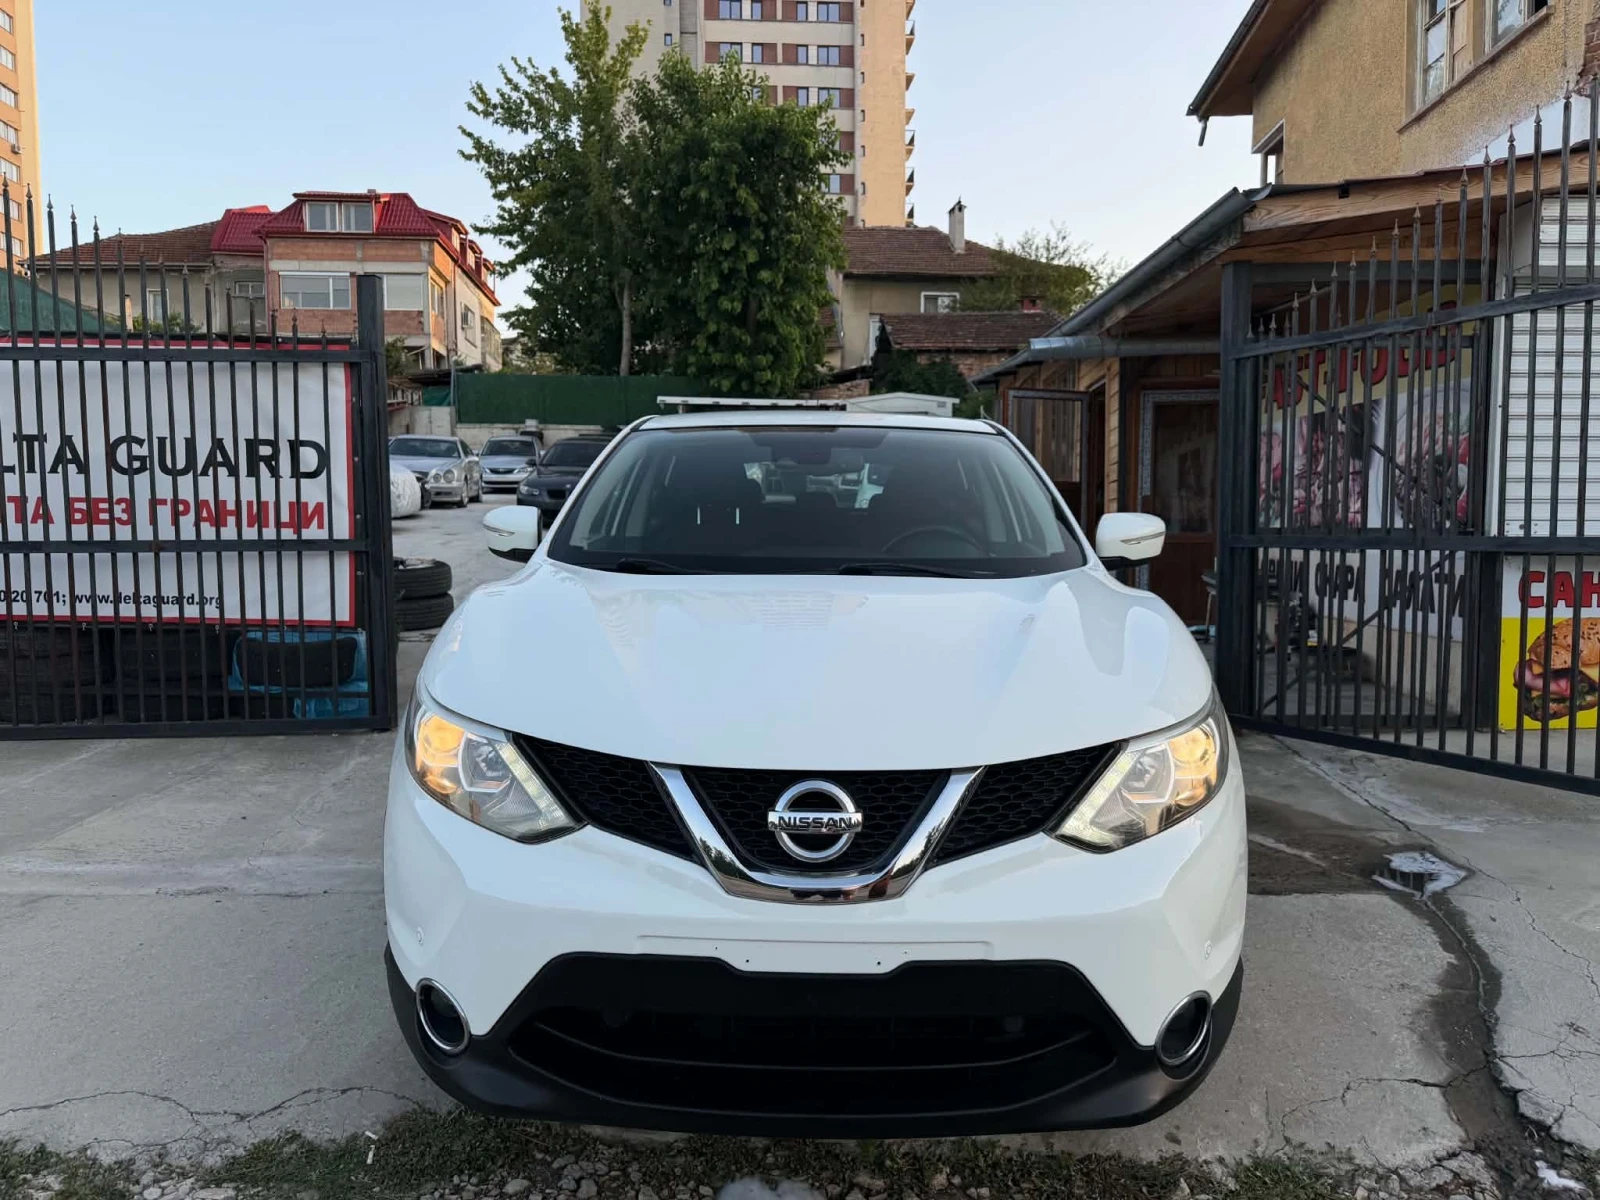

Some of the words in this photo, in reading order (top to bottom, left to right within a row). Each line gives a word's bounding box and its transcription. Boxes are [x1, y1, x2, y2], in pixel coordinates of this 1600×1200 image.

[0, 432, 86, 475] TA
[109, 435, 327, 479] GUARD
[68, 496, 132, 526] БЕЗ
[148, 498, 325, 535] ГРАНИЦИ
[777, 815, 852, 829] NISSAN
